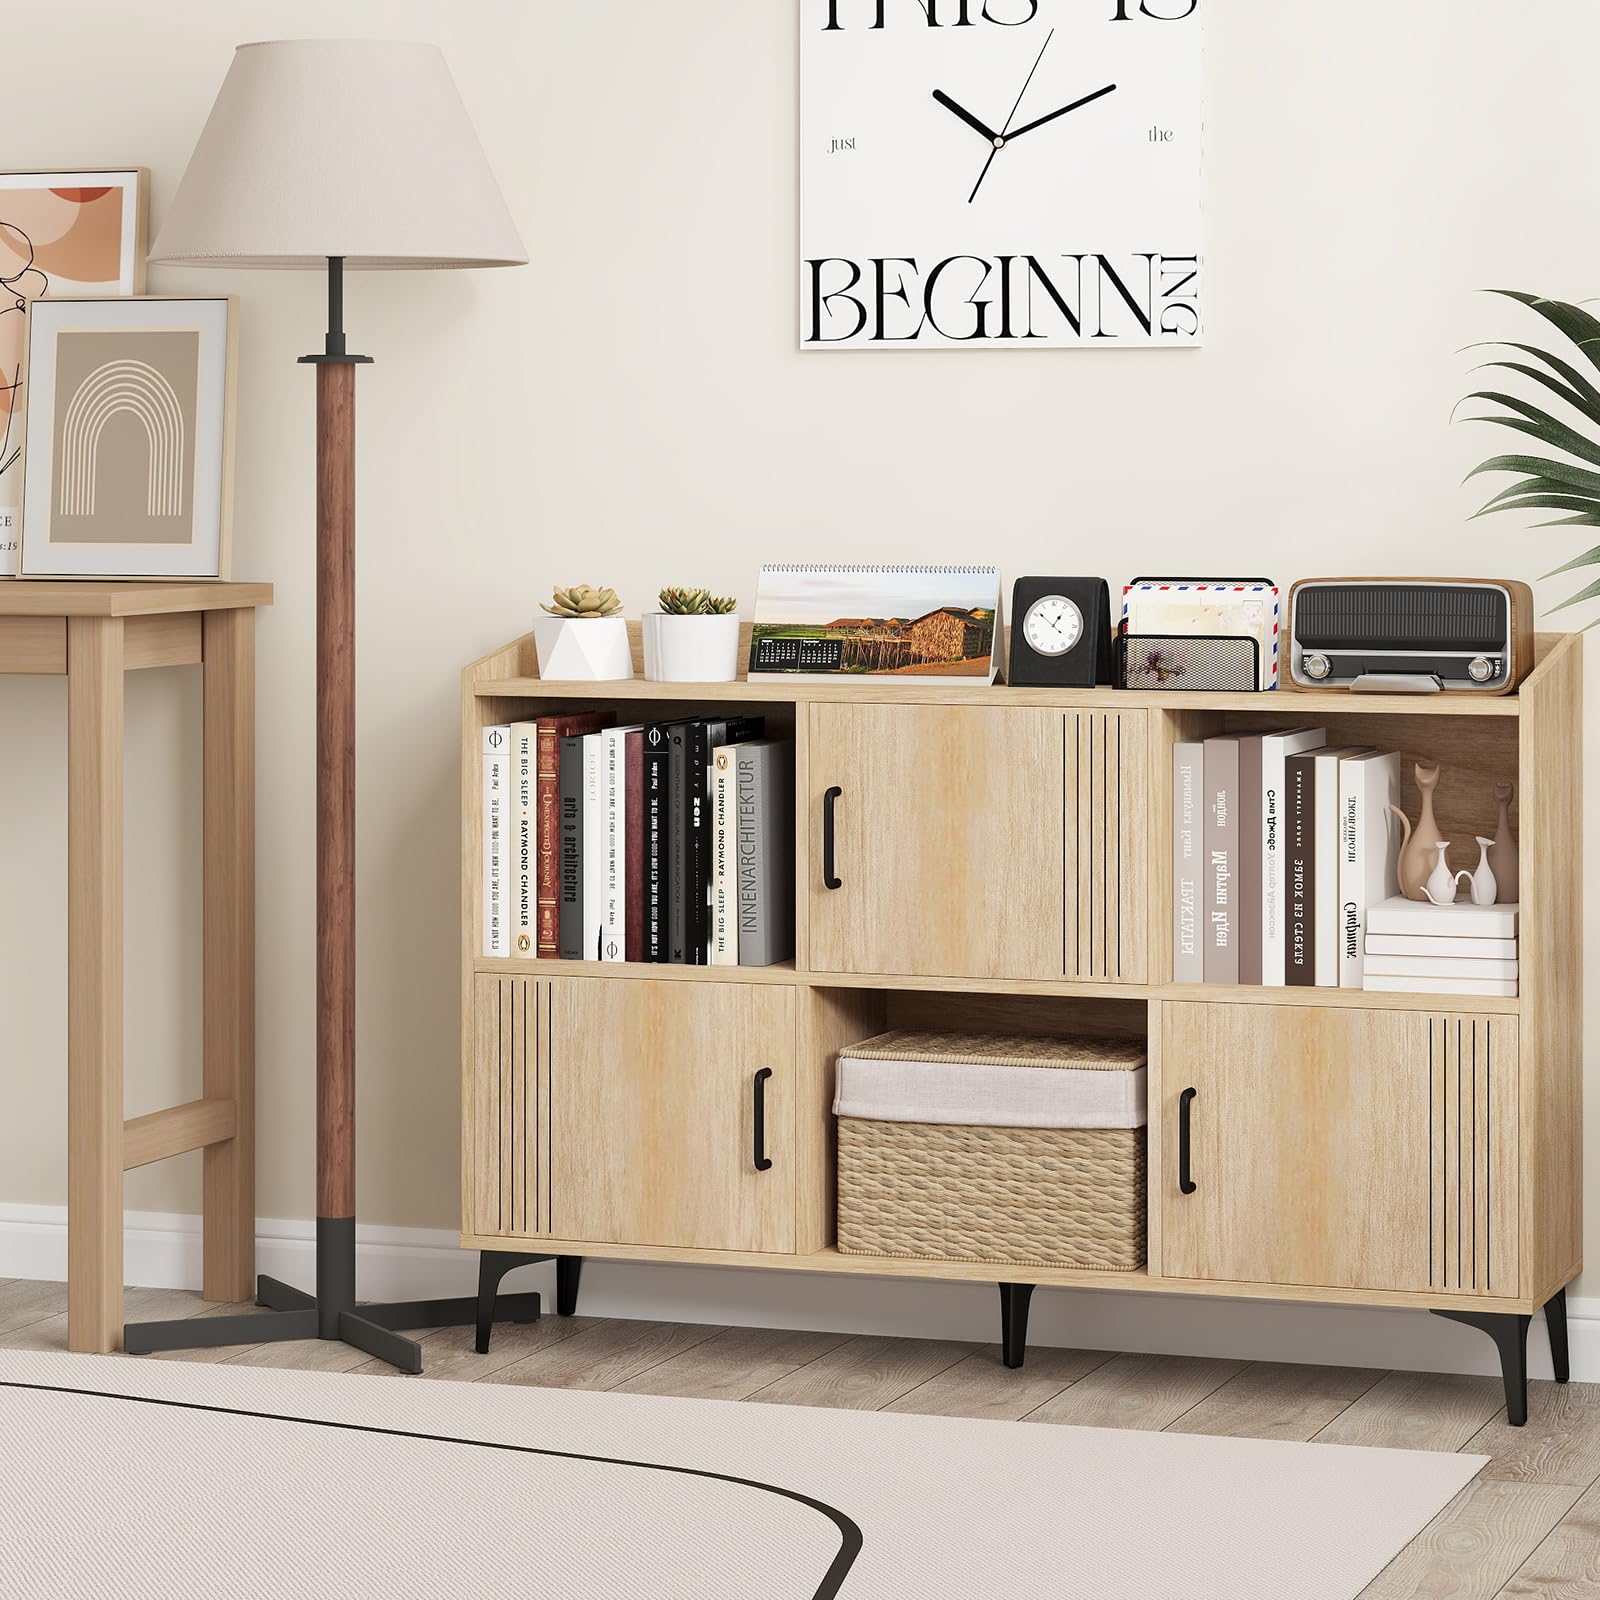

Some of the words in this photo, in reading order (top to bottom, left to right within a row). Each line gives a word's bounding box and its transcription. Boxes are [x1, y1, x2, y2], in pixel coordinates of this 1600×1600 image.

[826, 135, 856, 153] just
[1148, 126, 1174, 142] the
[804, 253, 1160, 342] BEGINN
[1161, 255, 1199, 337] ING
[521, 737, 529, 755] THE
[491, 764, 499, 777] Arden
[521, 759, 529, 776] BIG
[491, 779, 499, 790] Paul
[521, 780, 529, 807] SLEEP
[564, 797, 579, 818] arts
[675, 800, 680, 810] OF
[693, 797, 701, 827] zen
[491, 815, 499, 828] WANT
[542, 793, 552, 849] UNEXPECTED
[521, 820, 529, 871] RAYMOND
[739, 761, 757, 933] INNENARCHITEKTUR
[491, 855, 499, 866] HOW
[541, 849, 552, 888] JOURNEY
[564, 836, 579, 903] architecture
[491, 868, 499, 877] IT'S
[491, 891, 499, 901] YOU
[521, 875, 529, 926] CHANDLER
[491, 917, 499, 928] HOW
[491, 929, 499, 939] NOT
[491, 940, 499, 950] IT'S
